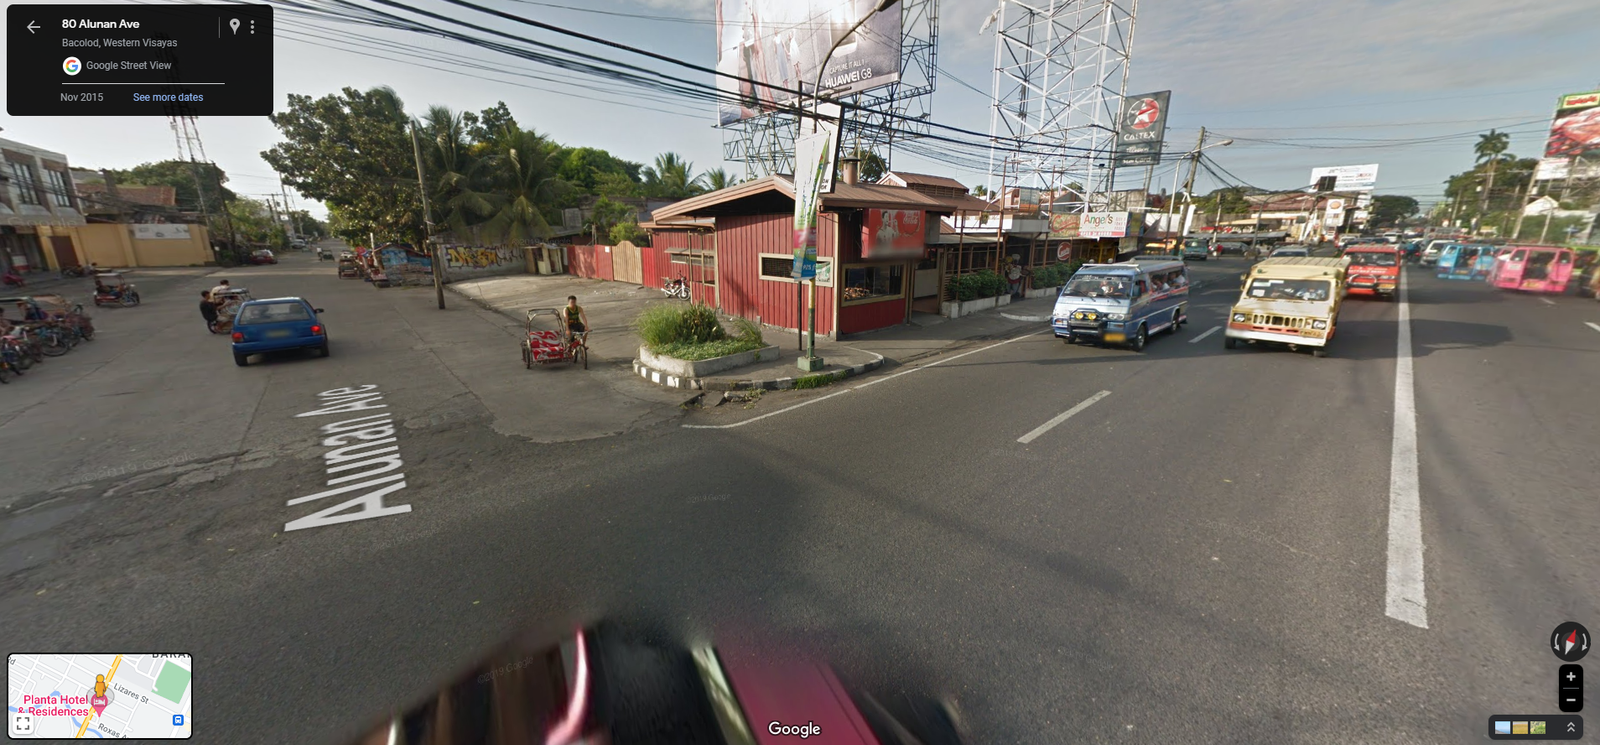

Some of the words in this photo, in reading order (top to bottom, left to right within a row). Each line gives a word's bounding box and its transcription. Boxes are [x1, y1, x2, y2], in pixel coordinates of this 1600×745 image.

[829, 62, 848, 74] CAPTURE
[853, 60, 862, 68] ALL
[825, 71, 860, 88] HUAWEI
[860, 67, 872, 80] G8
[1123, 130, 1155, 141] CALTEX
[1083, 213, 1114, 227] Angel's
